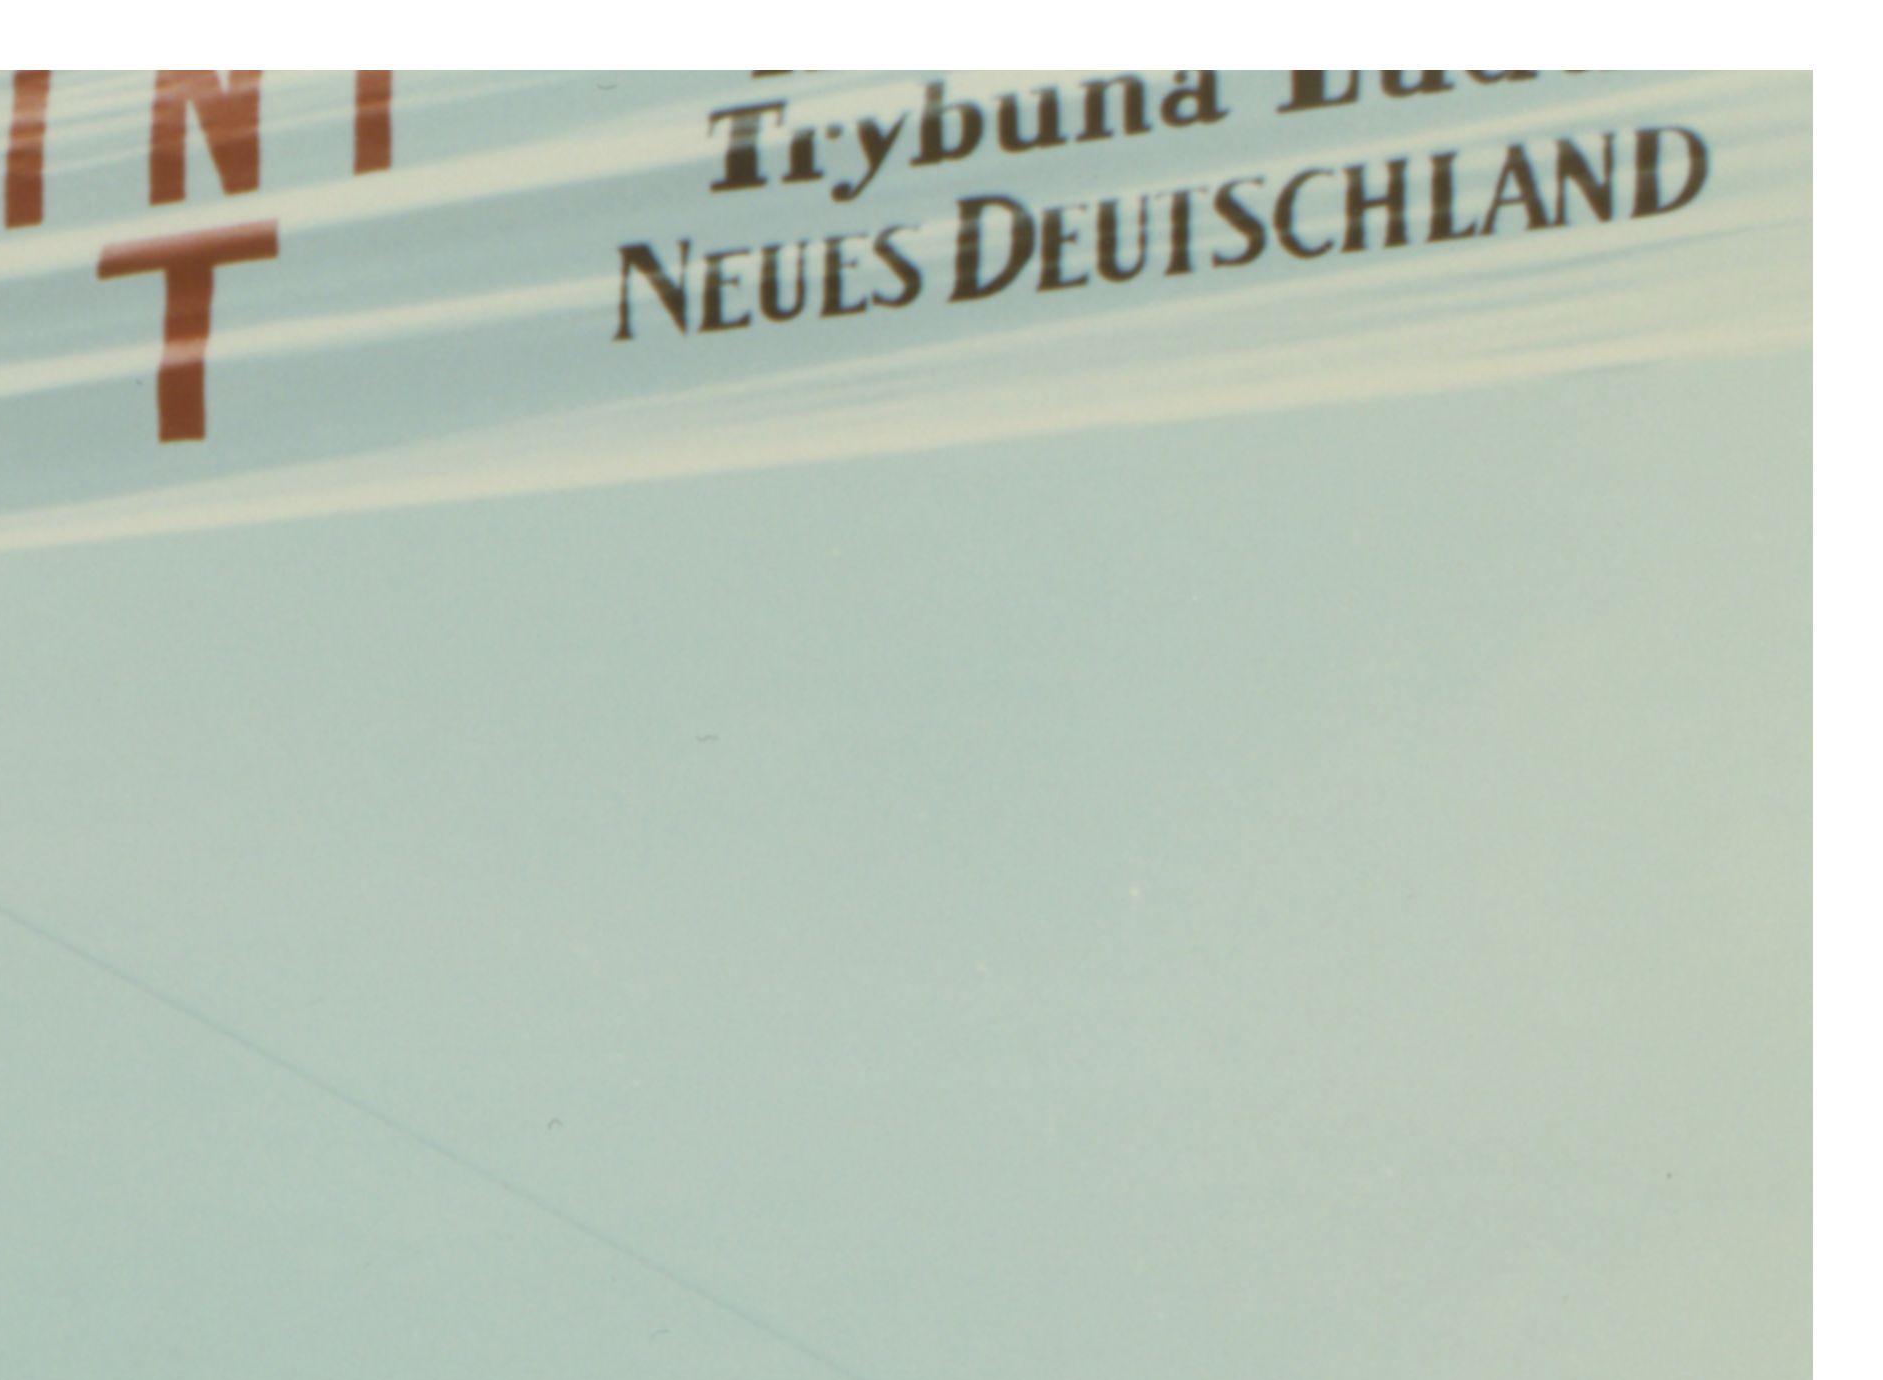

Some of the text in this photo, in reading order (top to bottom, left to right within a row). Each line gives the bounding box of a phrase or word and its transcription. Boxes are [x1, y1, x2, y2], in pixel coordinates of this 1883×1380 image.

[708, 70, 1230, 201] Trybuna
[613, 126, 1710, 342] NEUES DEUTSCHLAND
